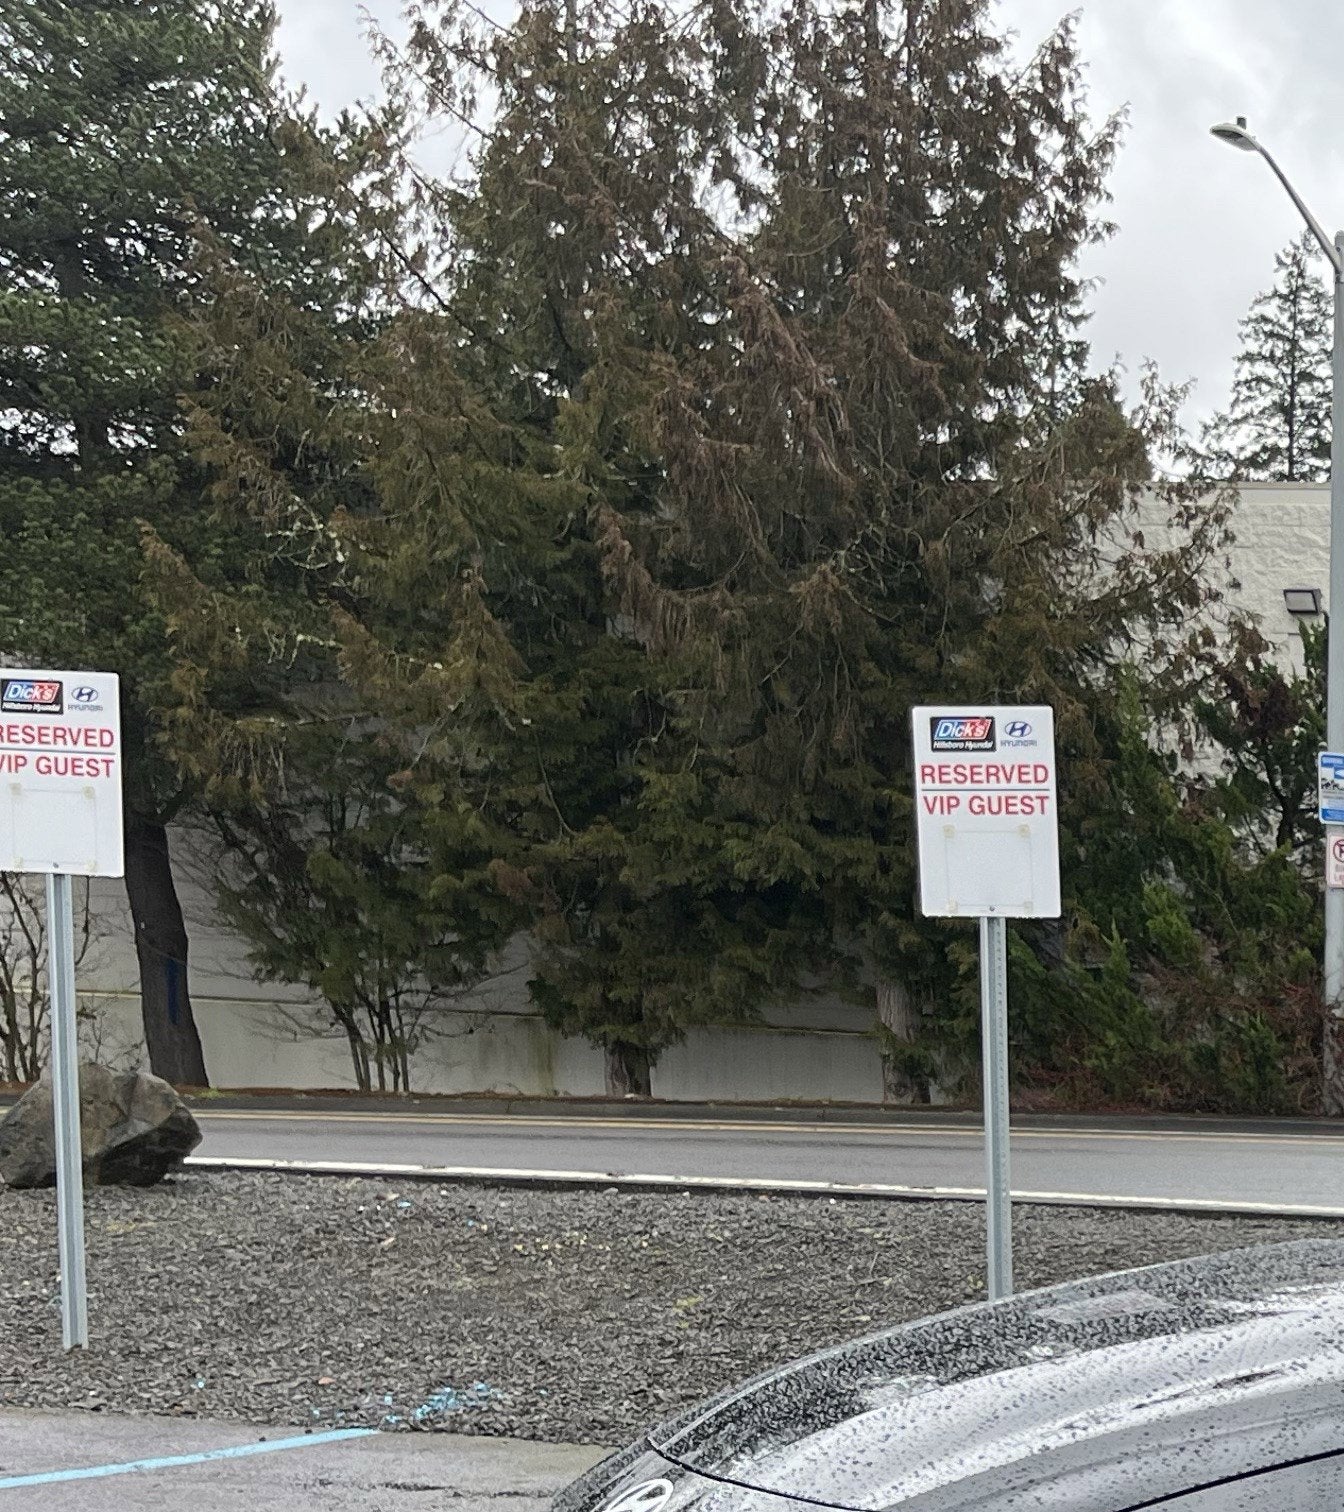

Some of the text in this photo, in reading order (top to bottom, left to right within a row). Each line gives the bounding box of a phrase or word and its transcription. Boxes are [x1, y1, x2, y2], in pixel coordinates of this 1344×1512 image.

[35, 755, 116, 778] GUEST
[920, 764, 1050, 785] RESERVED
[923, 795, 1050, 816] VIP GUEST
